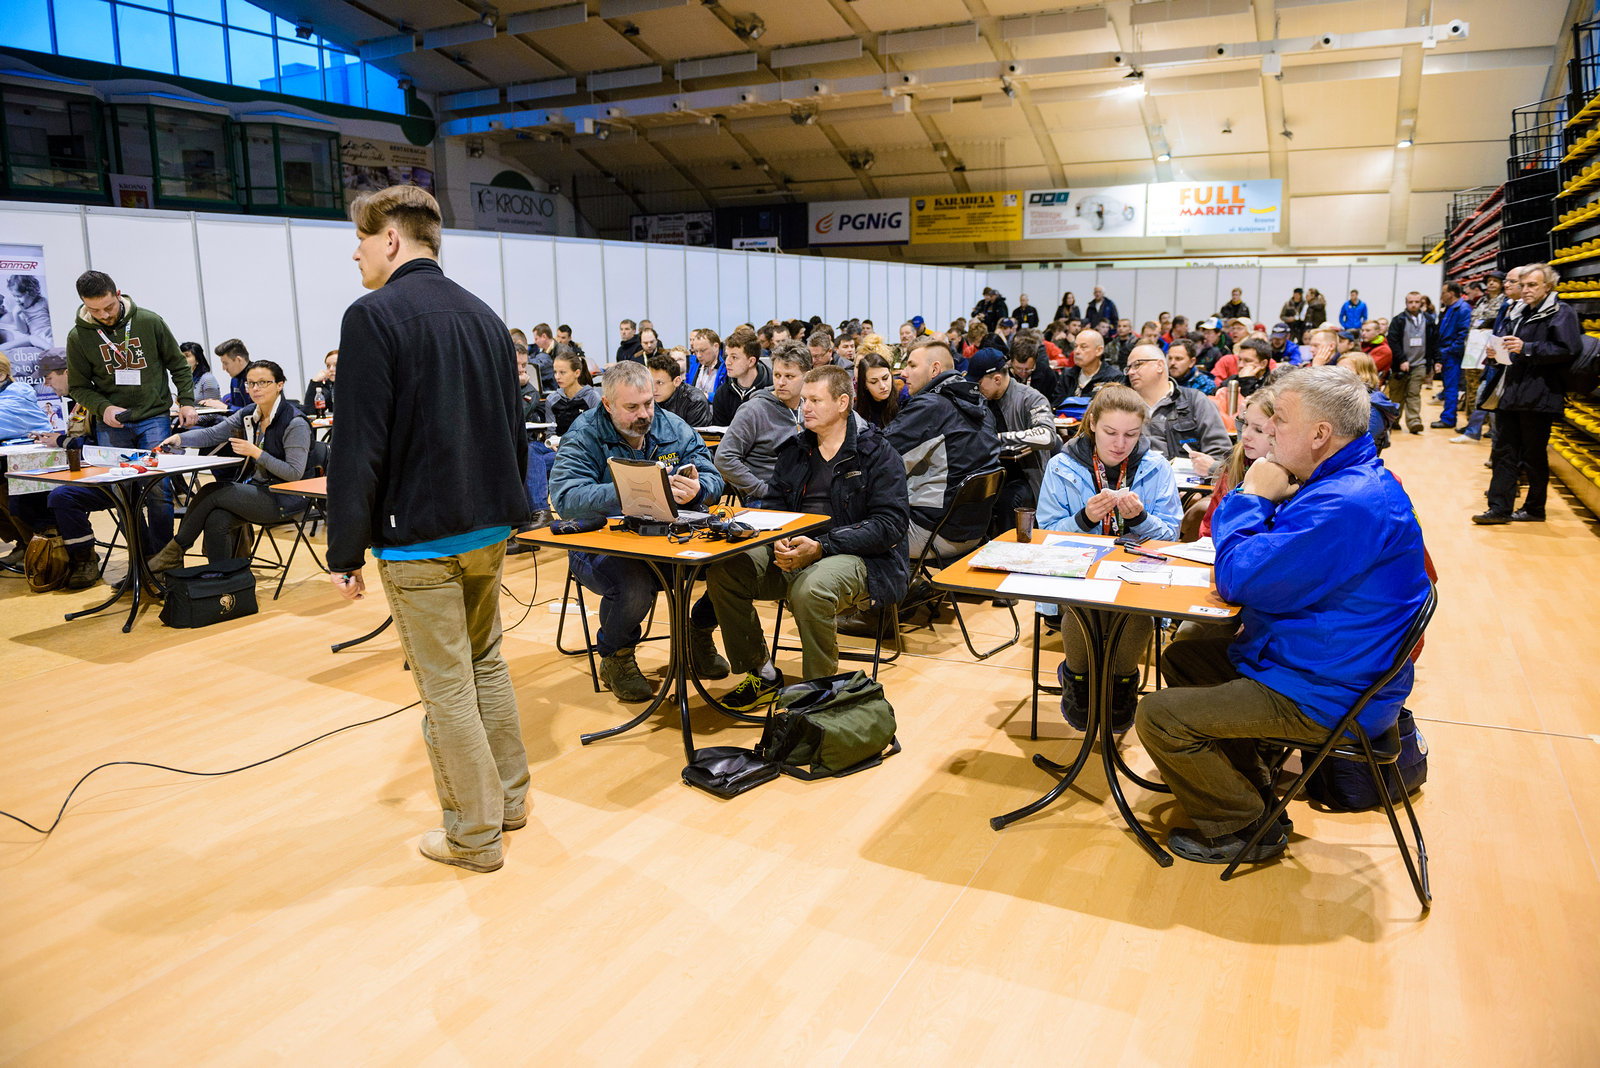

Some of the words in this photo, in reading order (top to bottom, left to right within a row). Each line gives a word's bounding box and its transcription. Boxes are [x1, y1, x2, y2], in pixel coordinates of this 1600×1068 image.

[934, 195, 995, 206] KARABELA
[1180, 185, 1245, 205] FULL
[495, 191, 554, 217] KROSNO
[1180, 205, 1245, 216] MARKET
[838, 212, 902, 231] PGNiG
[0, 261, 38, 270] anmaR
[658, 452, 677, 461] PILOT
